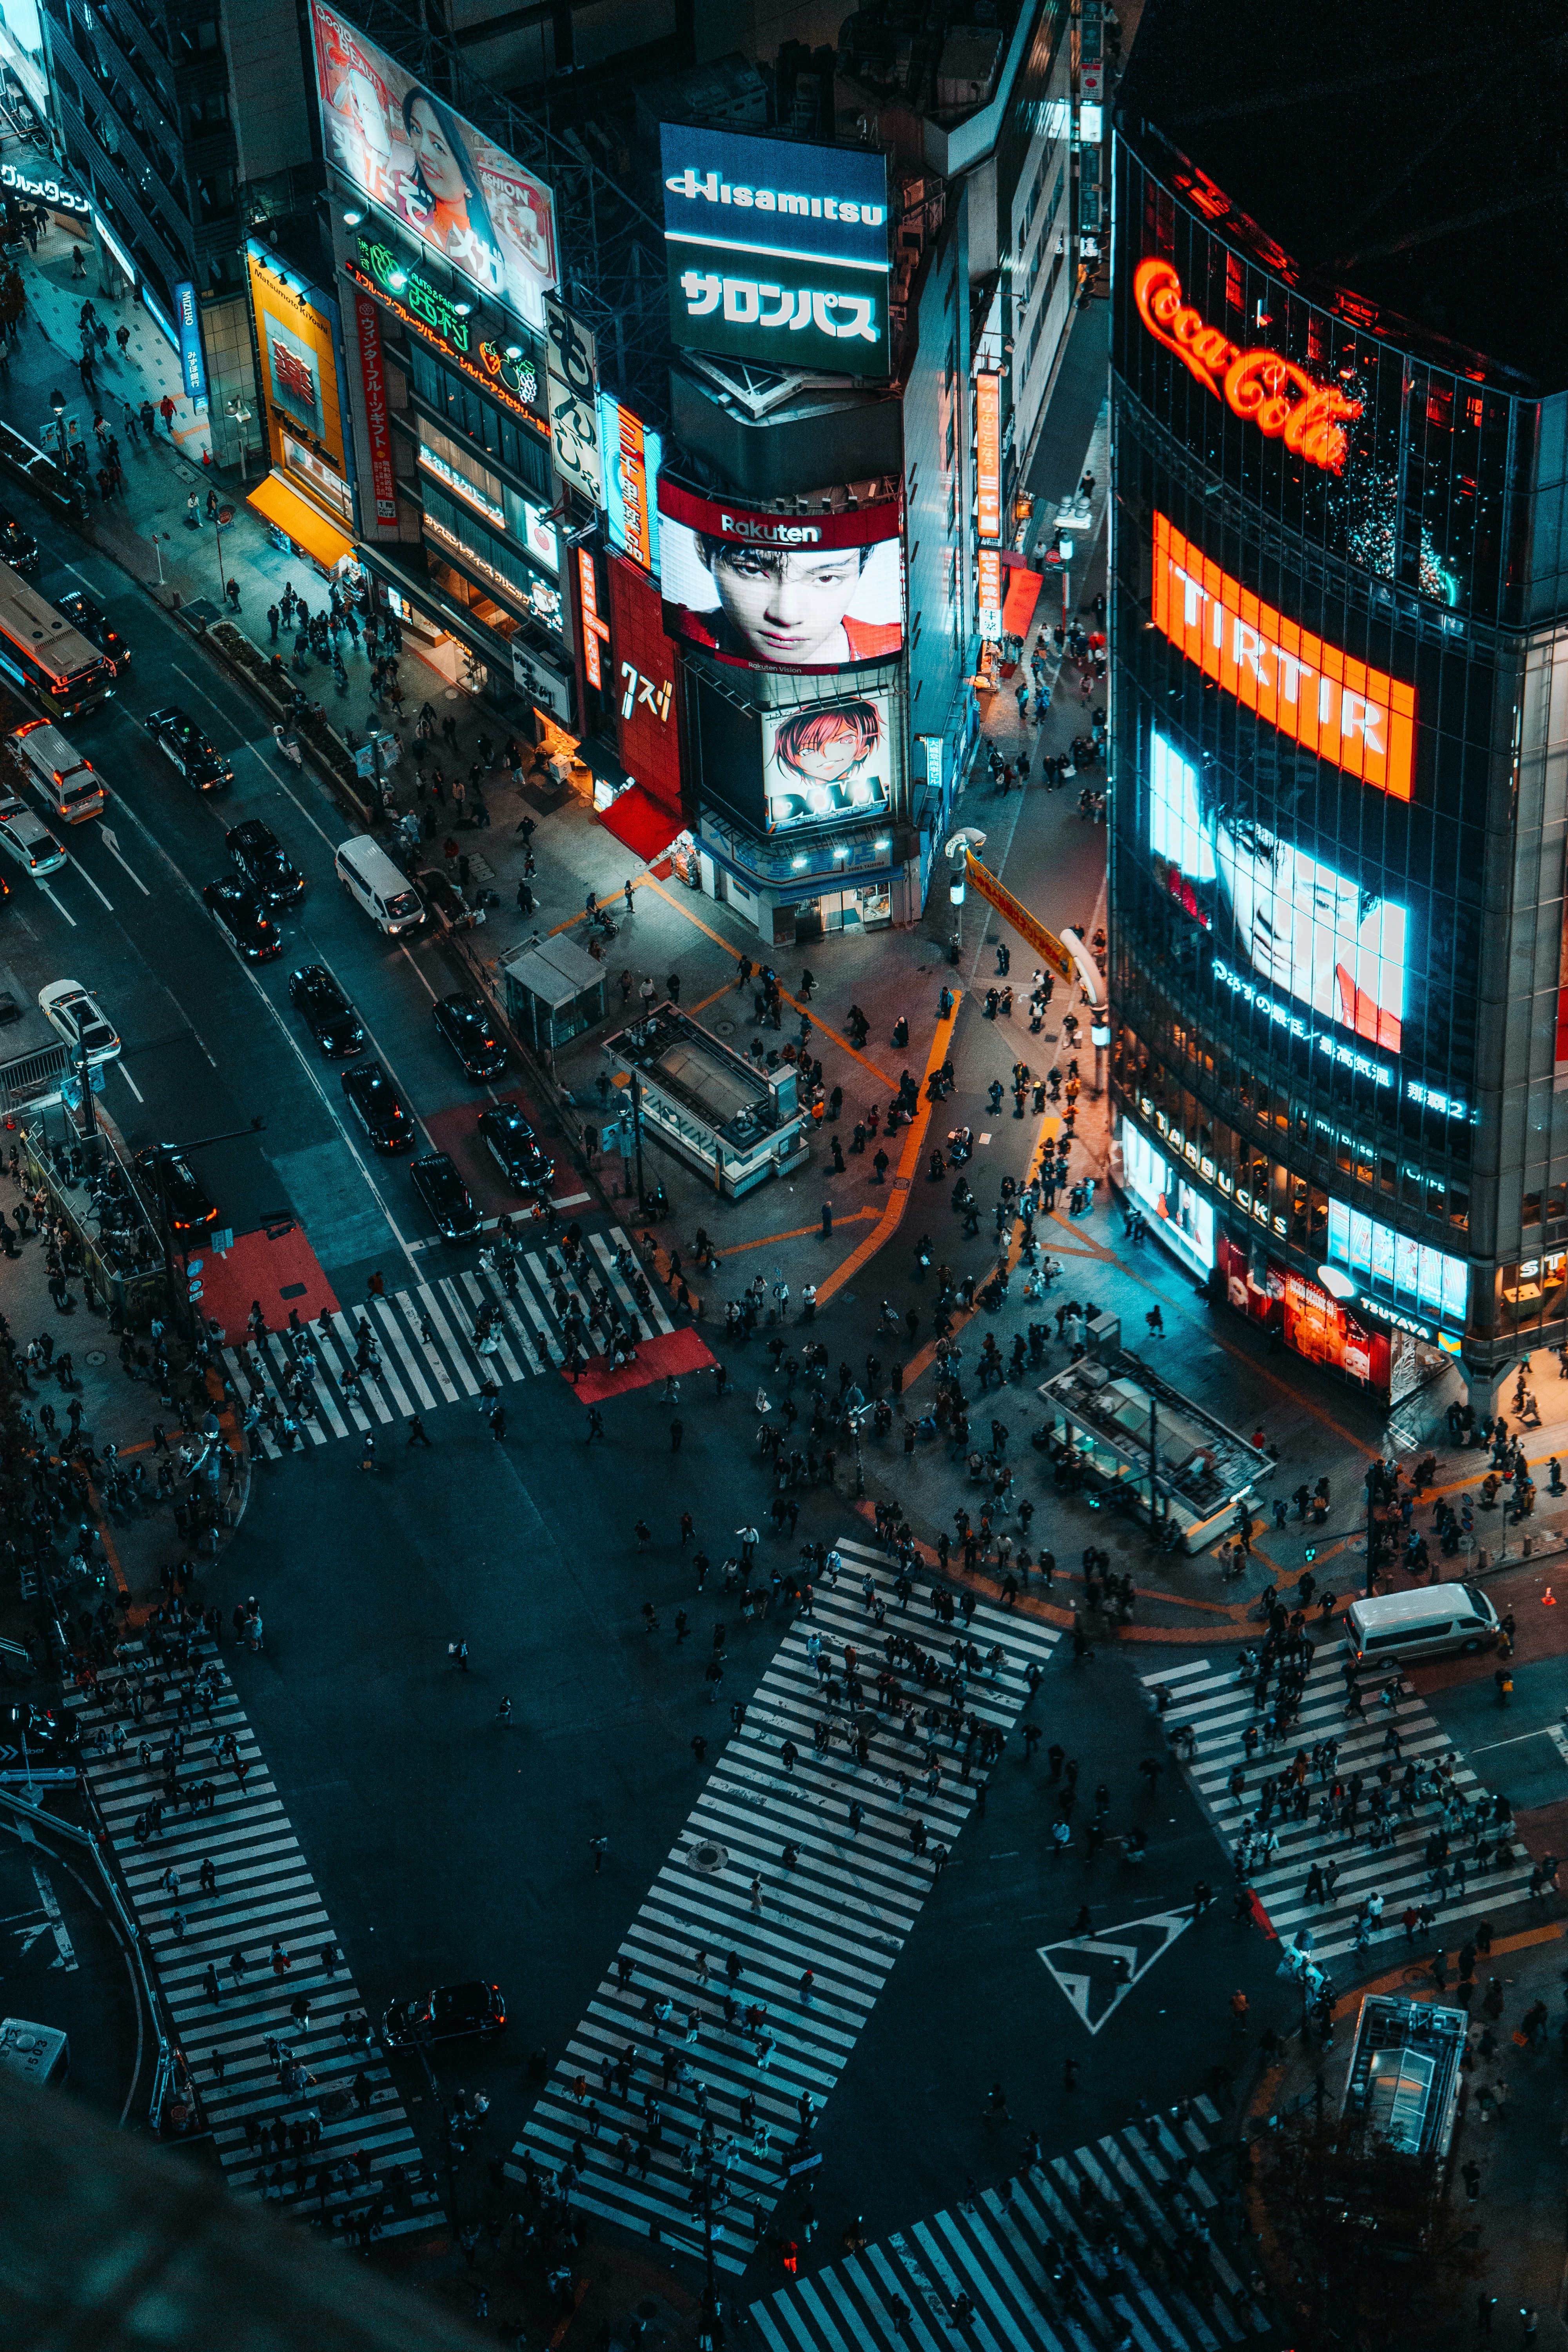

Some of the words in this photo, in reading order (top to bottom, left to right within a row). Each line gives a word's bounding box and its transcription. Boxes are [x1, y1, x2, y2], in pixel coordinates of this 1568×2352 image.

[315, 5, 352, 42] Qoo10
[340, 38, 381, 88] BEAUTY
[1, 164, 89, 212] グルメタウン
[666, 169, 882, 226] Hisamitsu
[182, 290, 193, 326] MIZUHO
[254, 268, 299, 310] Matsumoto
[681, 272, 878, 343] サロンパス
[187, 352, 200, 387] みずほ銀行
[981, 379, 996, 470] クスリのことなら
[618, 419, 644, 563] 三千里薬品
[979, 474, 998, 531] 三千里
[722, 514, 818, 543] Rakuten
[748, 661, 776, 672] Rakuten
[779, 665, 802, 674] Vision
[1175, 565, 1384, 754] TIRTIR
[621, 661, 673, 722] クスリ
[769, 775, 887, 824] DMM
[1141, 1098, 1287, 1235] STARBUCKS
[1361, 1297, 1429, 1339] TSUTAYA
